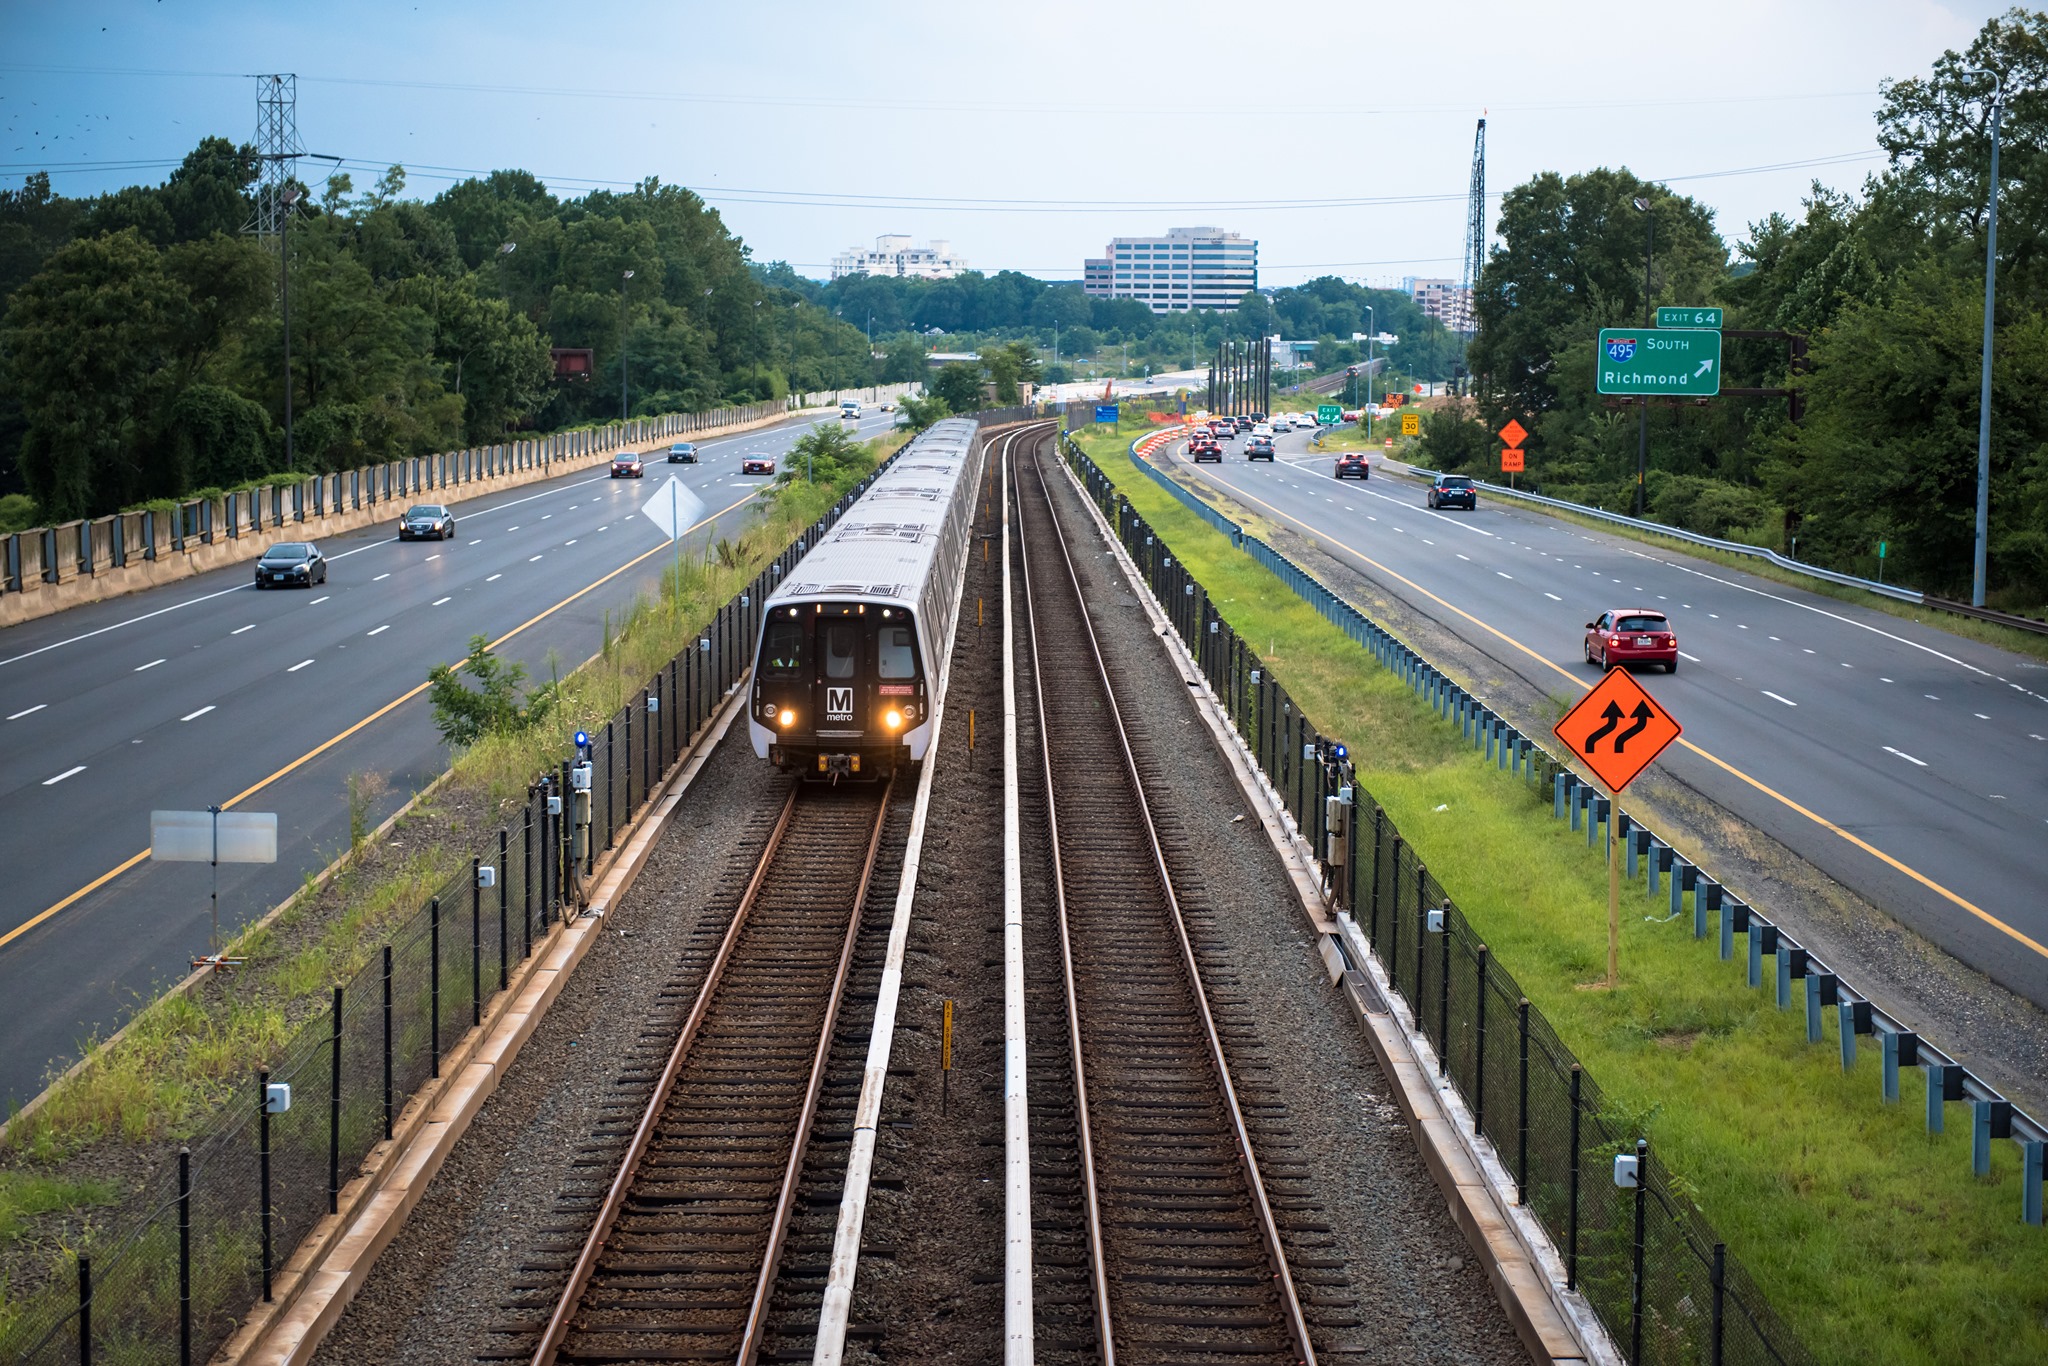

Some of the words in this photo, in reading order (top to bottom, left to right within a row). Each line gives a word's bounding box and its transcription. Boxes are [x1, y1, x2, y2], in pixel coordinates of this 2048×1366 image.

[1664, 313, 1689, 322] EXIT
[1694, 312, 1716, 324] 64
[1647, 338, 1689, 350] SOUTH
[1609, 344, 1634, 358] 495
[1605, 372, 1688, 385] Richmond
[1319, 413, 1330, 421] 64
[1405, 422, 1416, 430] 30
[829, 689, 851, 711] M
[827, 713, 853, 721] metro
